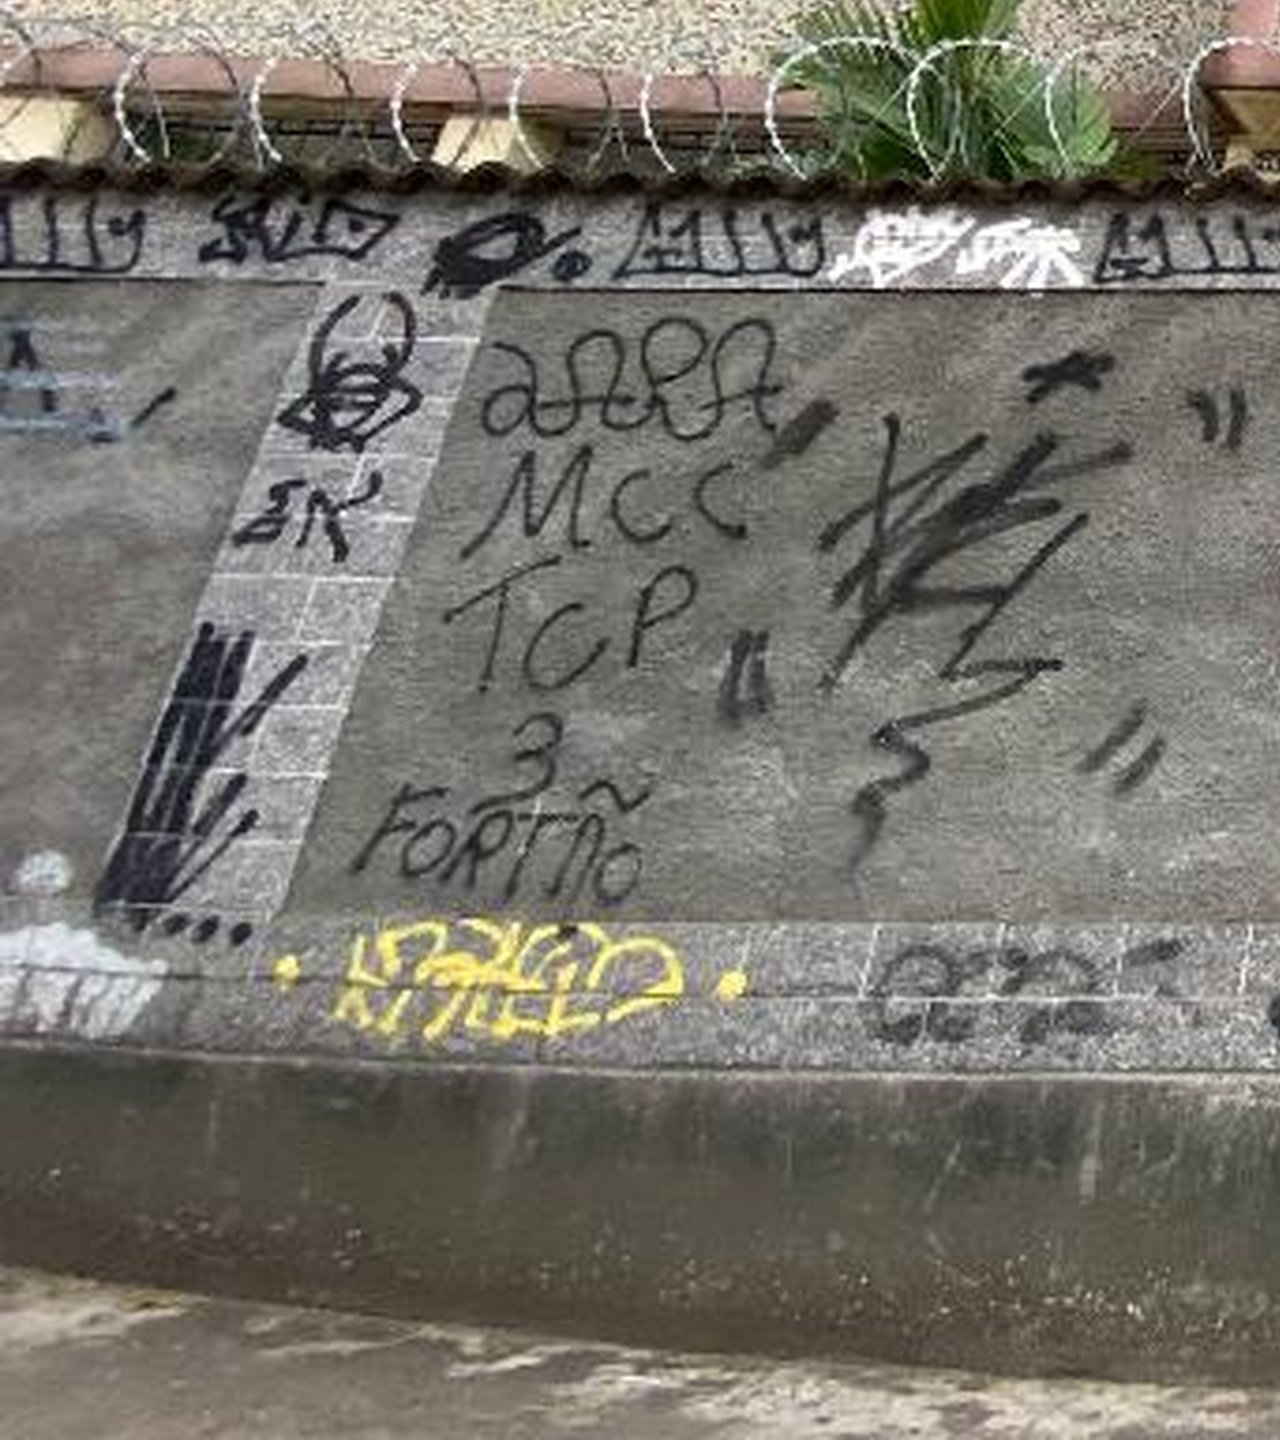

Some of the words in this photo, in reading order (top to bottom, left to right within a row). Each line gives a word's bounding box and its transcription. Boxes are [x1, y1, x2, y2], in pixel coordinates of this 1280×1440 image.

[459, 444, 748, 560] MCC
[443, 557, 697, 692] TCP
[470, 712, 564, 816] 3
